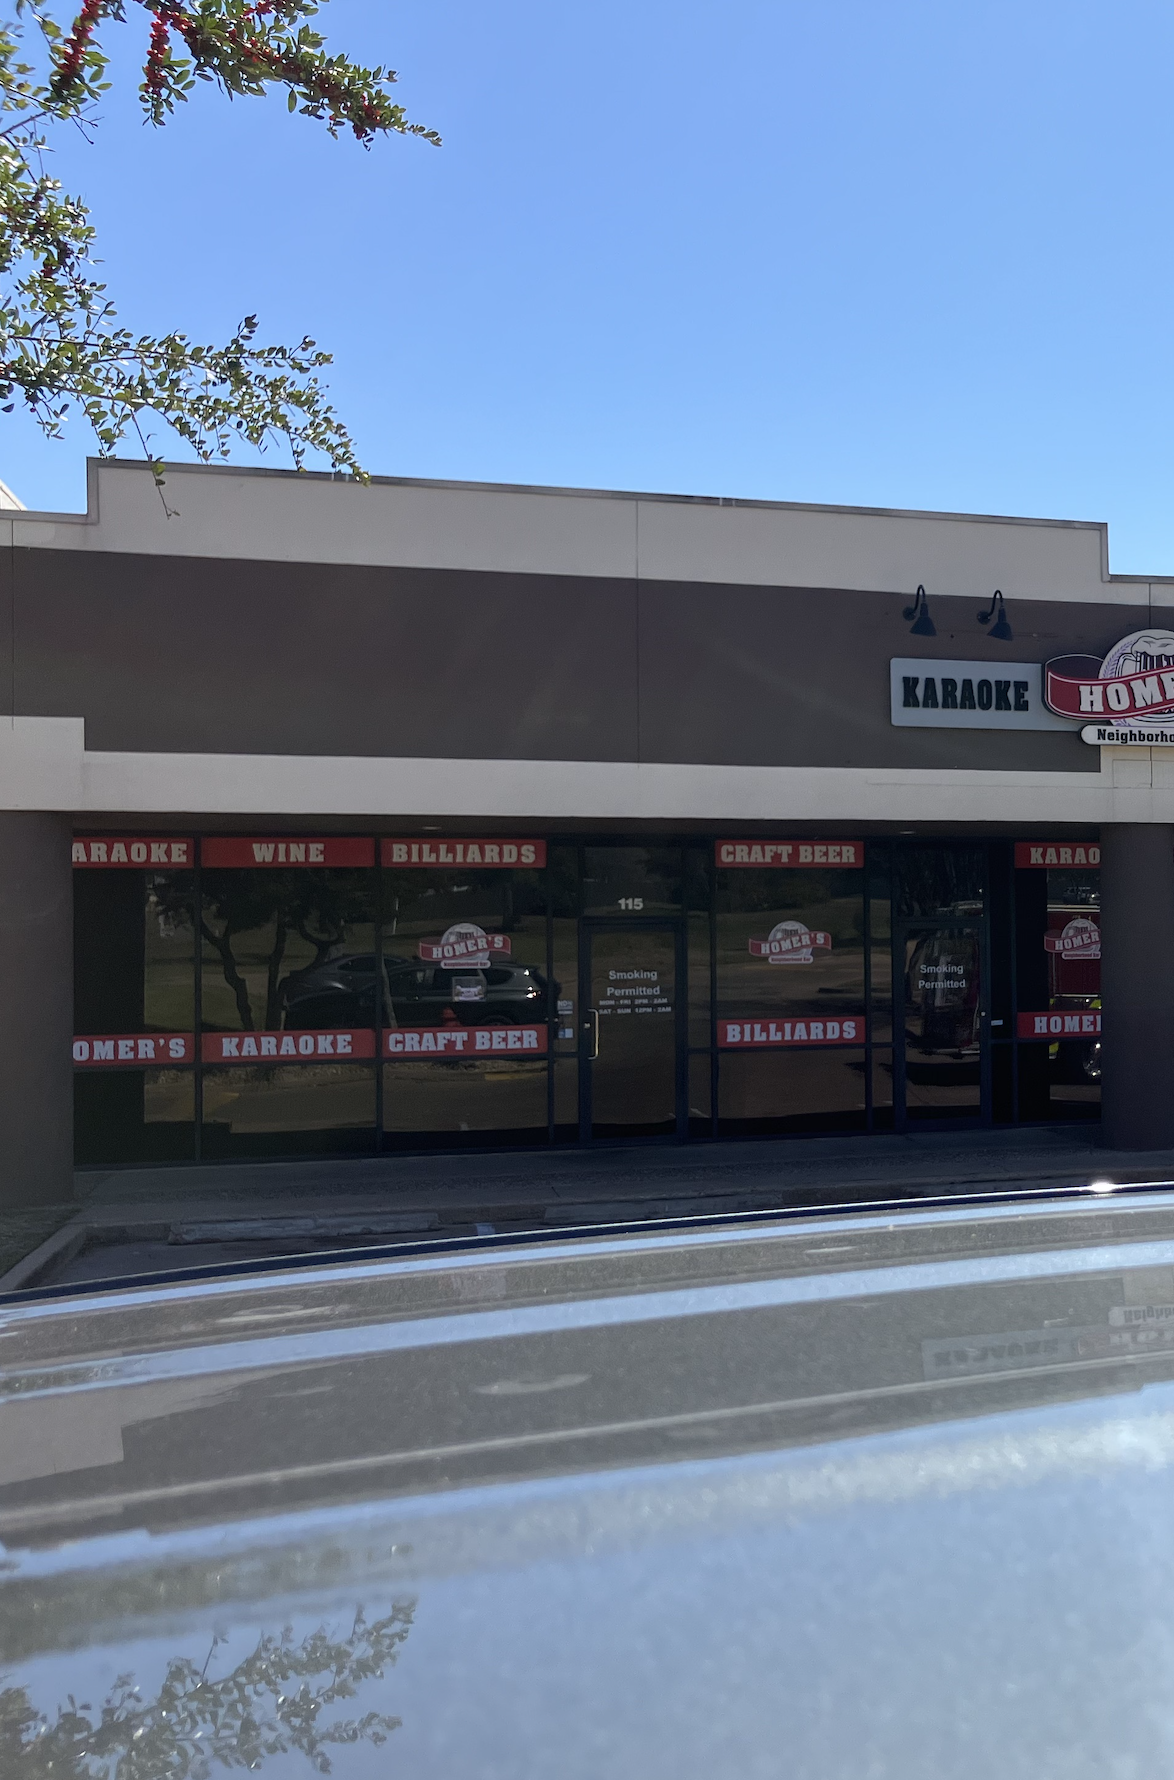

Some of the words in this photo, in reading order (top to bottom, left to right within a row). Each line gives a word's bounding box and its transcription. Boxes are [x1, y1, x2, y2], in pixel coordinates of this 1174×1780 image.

[902, 676, 1029, 711] KARAOKE
[252, 843, 324, 863] WINE
[392, 843, 536, 864] BILLIARDS
[721, 844, 793, 863] CRAFT
[799, 845, 855, 863] BEER
[618, 898, 644, 910] 115
[432, 936, 504, 958] HOMER'S
[761, 933, 825, 954] HOMER'S
[609, 969, 658, 981] Smoking
[920, 964, 963, 974] Smoking
[607, 986, 660, 996] Permitted
[918, 979, 966, 989] Permitted
[389, 1031, 468, 1052] CRAFT
[475, 1030, 538, 1050] BEER
[726, 1021, 856, 1043] BILLIARDS
[222, 1034, 352, 1057] KARAOKE
